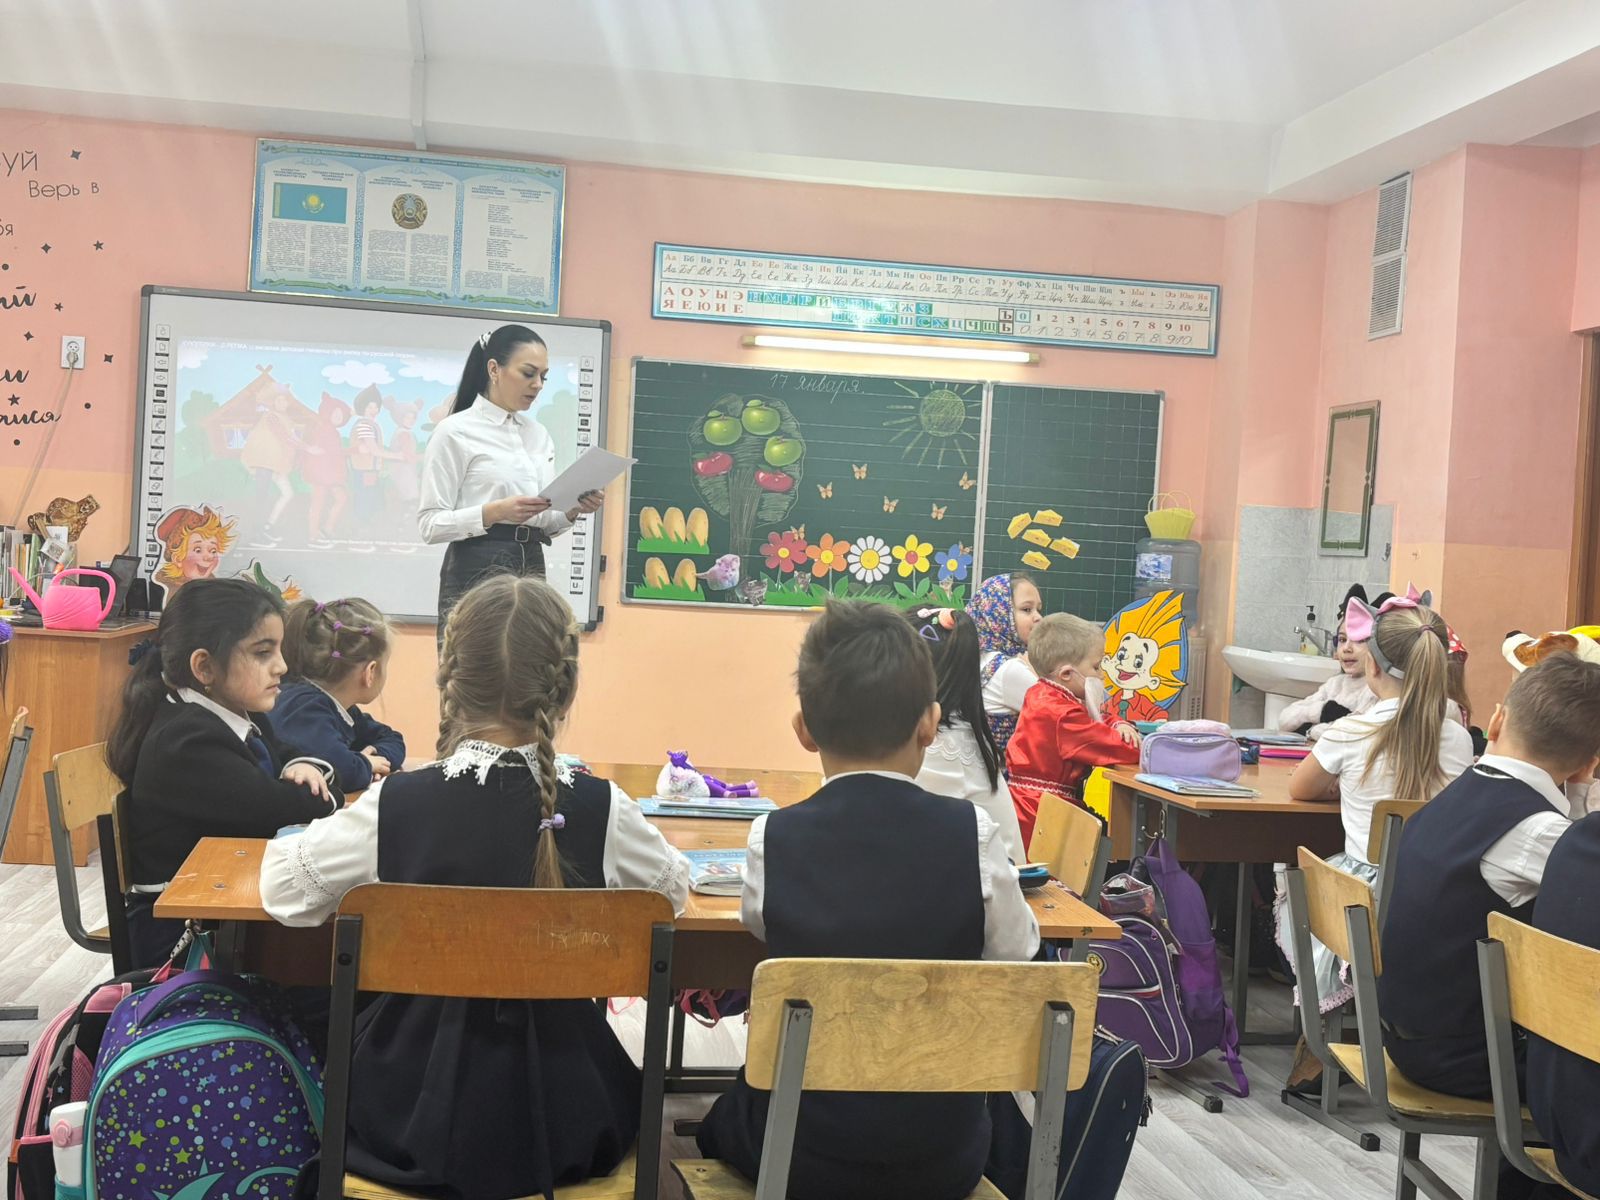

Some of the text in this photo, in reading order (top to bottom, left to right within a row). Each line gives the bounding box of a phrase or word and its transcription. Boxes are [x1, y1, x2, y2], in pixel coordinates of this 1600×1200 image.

[0, 150, 38, 177] уй
[28, 180, 100, 200] Верь в
[664, 286, 674, 296] А
[682, 287, 694, 297] О
[699, 288, 710, 298] У
[716, 290, 728, 300] Ы
[732, 291, 744, 300] Э
[768, 293, 780, 304] М
[801, 296, 812, 306] Р
[902, 303, 914, 313] Ж
[920, 304, 929, 314] З
[1000, 311, 1012, 320] Ъ
[1067, 316, 1075, 324] 3
[1165, 322, 1172, 330] 9
[1180, 324, 1191, 332] 10
[664, 300, 674, 308] Я
[698, 302, 711, 312] Ю
[716, 303, 726, 312] И
[900, 316, 912, 326] Ш
[918, 316, 929, 326] С
[968, 321, 978, 330] Ч
[982, 323, 996, 332] Щ
[1002, 322, 1011, 332] Ь
[1054, 327, 1064, 336] 2
[1070, 328, 1078, 338] 3
[1086, 329, 1096, 338] 4
[1102, 330, 1112, 340] 5
[1117, 331, 1127, 341] 6
[1135, 332, 1144, 342] 7
[1150, 333, 1160, 343] 8
[1168, 334, 1176, 344] 9
[770, 373, 788, 390] 17
